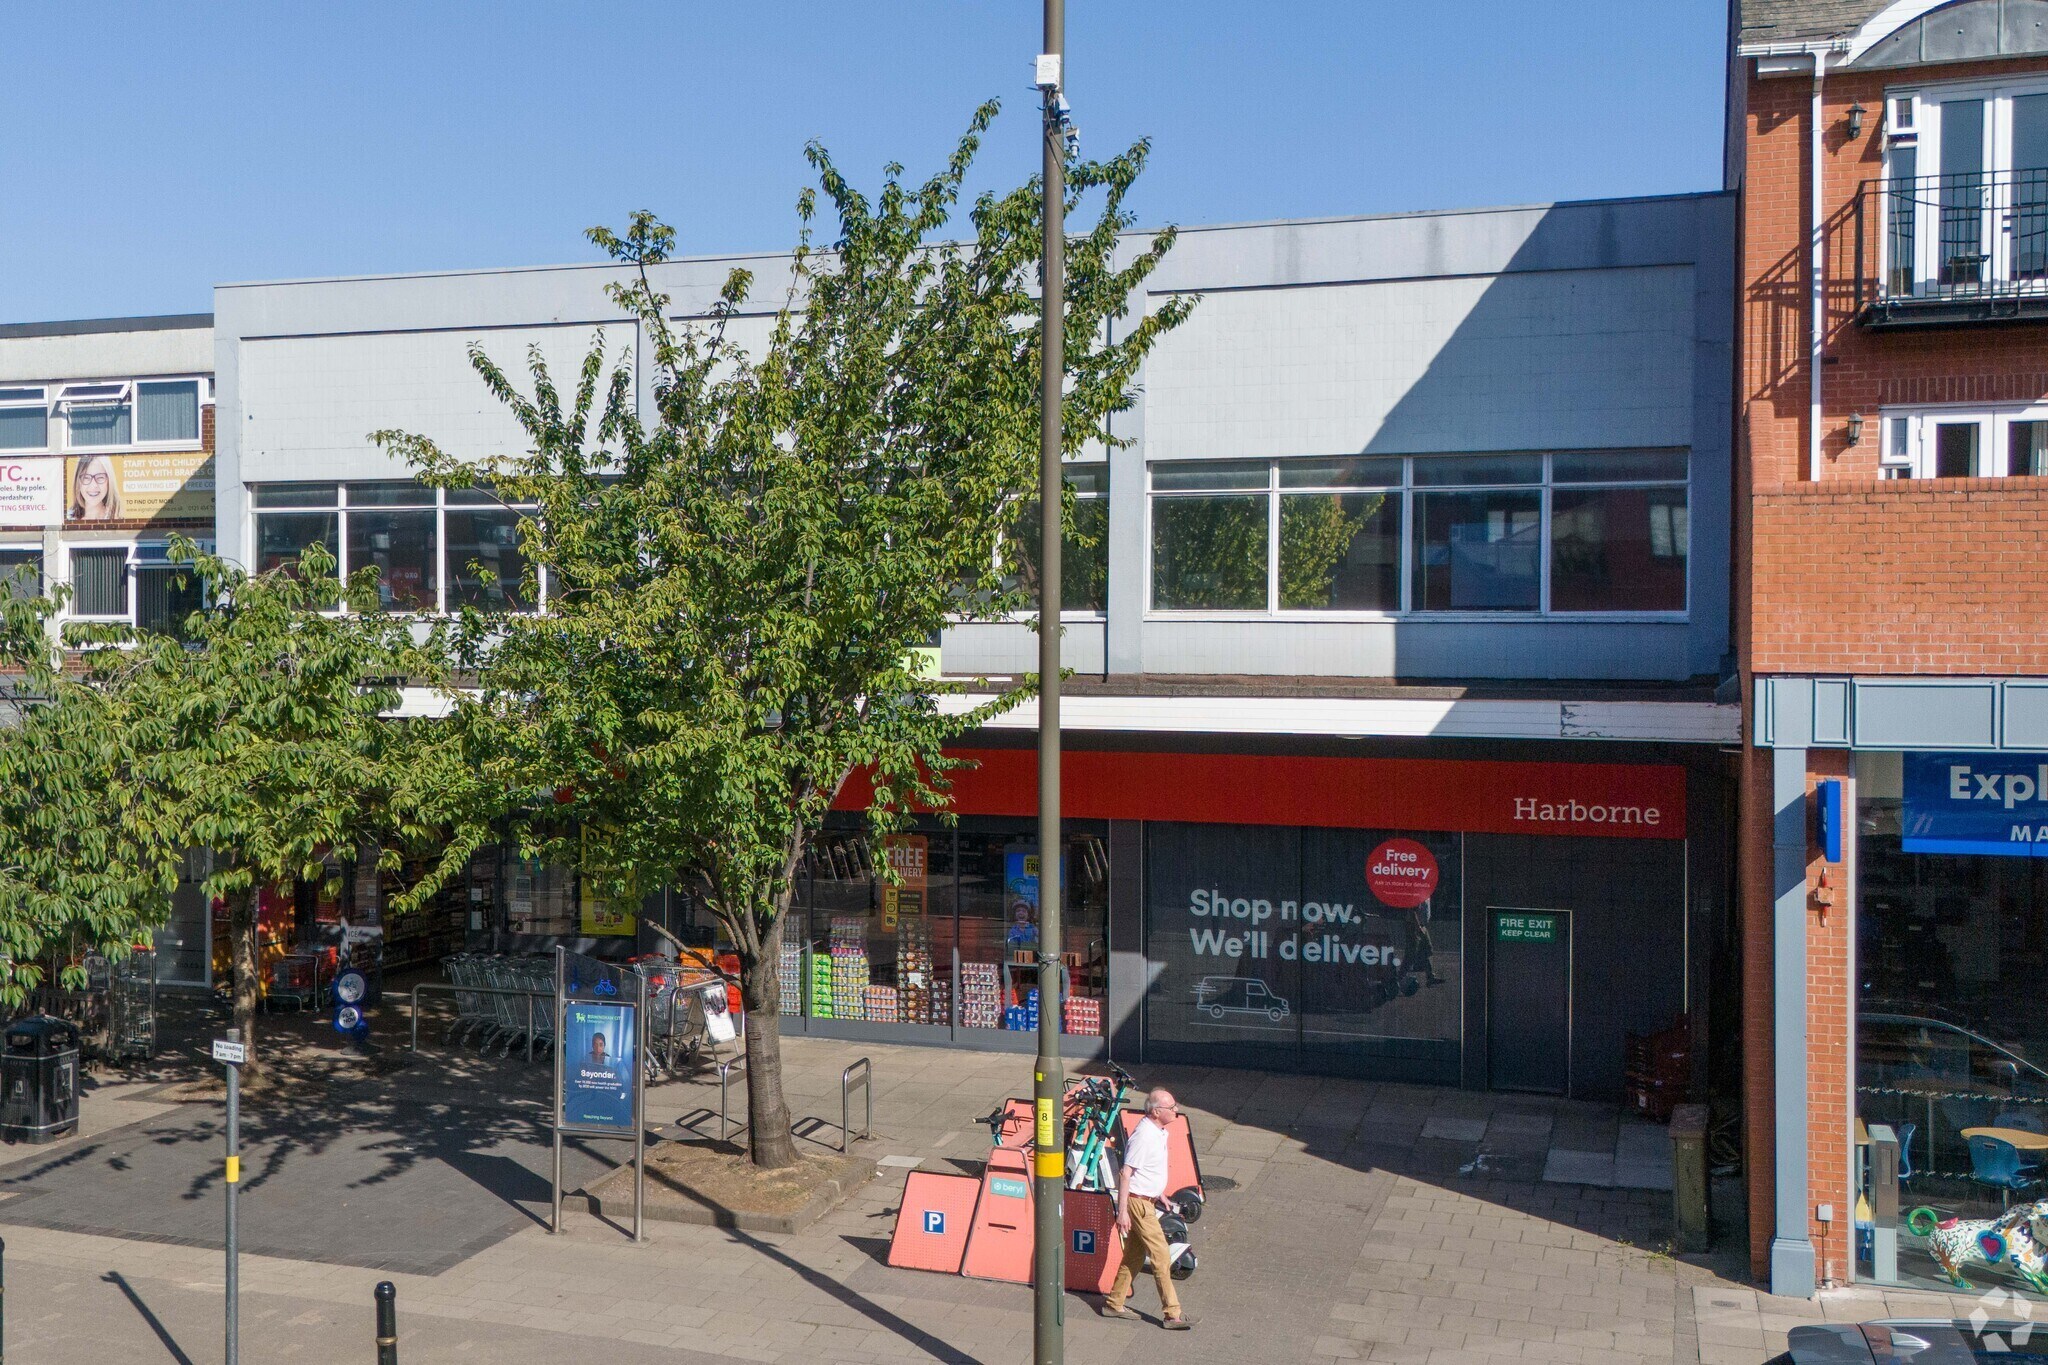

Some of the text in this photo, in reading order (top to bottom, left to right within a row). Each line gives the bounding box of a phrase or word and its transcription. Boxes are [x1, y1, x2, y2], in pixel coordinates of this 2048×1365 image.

[123, 460, 145, 468] START
[148, 459, 170, 467] YOUR
[172, 457, 202, 466] CHILD'S
[123, 469, 150, 478] TODAY
[152, 468, 173, 477] WITH
[174, 467, 205, 477] BRACES
[16, 485, 27, 493] Bay
[29, 484, 47, 492] poles.
[137, 482, 163, 490] WAITING
[165, 481, 178, 489] LIST
[187, 480, 202, 488] FREE
[1949, 764, 2048, 809] Expl
[1513, 797, 1661, 826] Harborne
[886, 847, 923, 867] FREE
[1386, 848, 1417, 862] Free
[1372, 863, 1430, 880] delivery
[1189, 888, 1361, 926] Shop now.
[1500, 918, 1552, 929] FIRE EXIT
[1501, 929, 1550, 938] KEEP CLEAR
[1189, 928, 1402, 967] We'll deliver.
[224, 1044, 242, 1052] loading
[1042, 1113, 1048, 1121] 8
[1002, 1182, 1023, 1193] beryl
[928, 1212, 942, 1231] P
[1078, 1232, 1091, 1250] P
